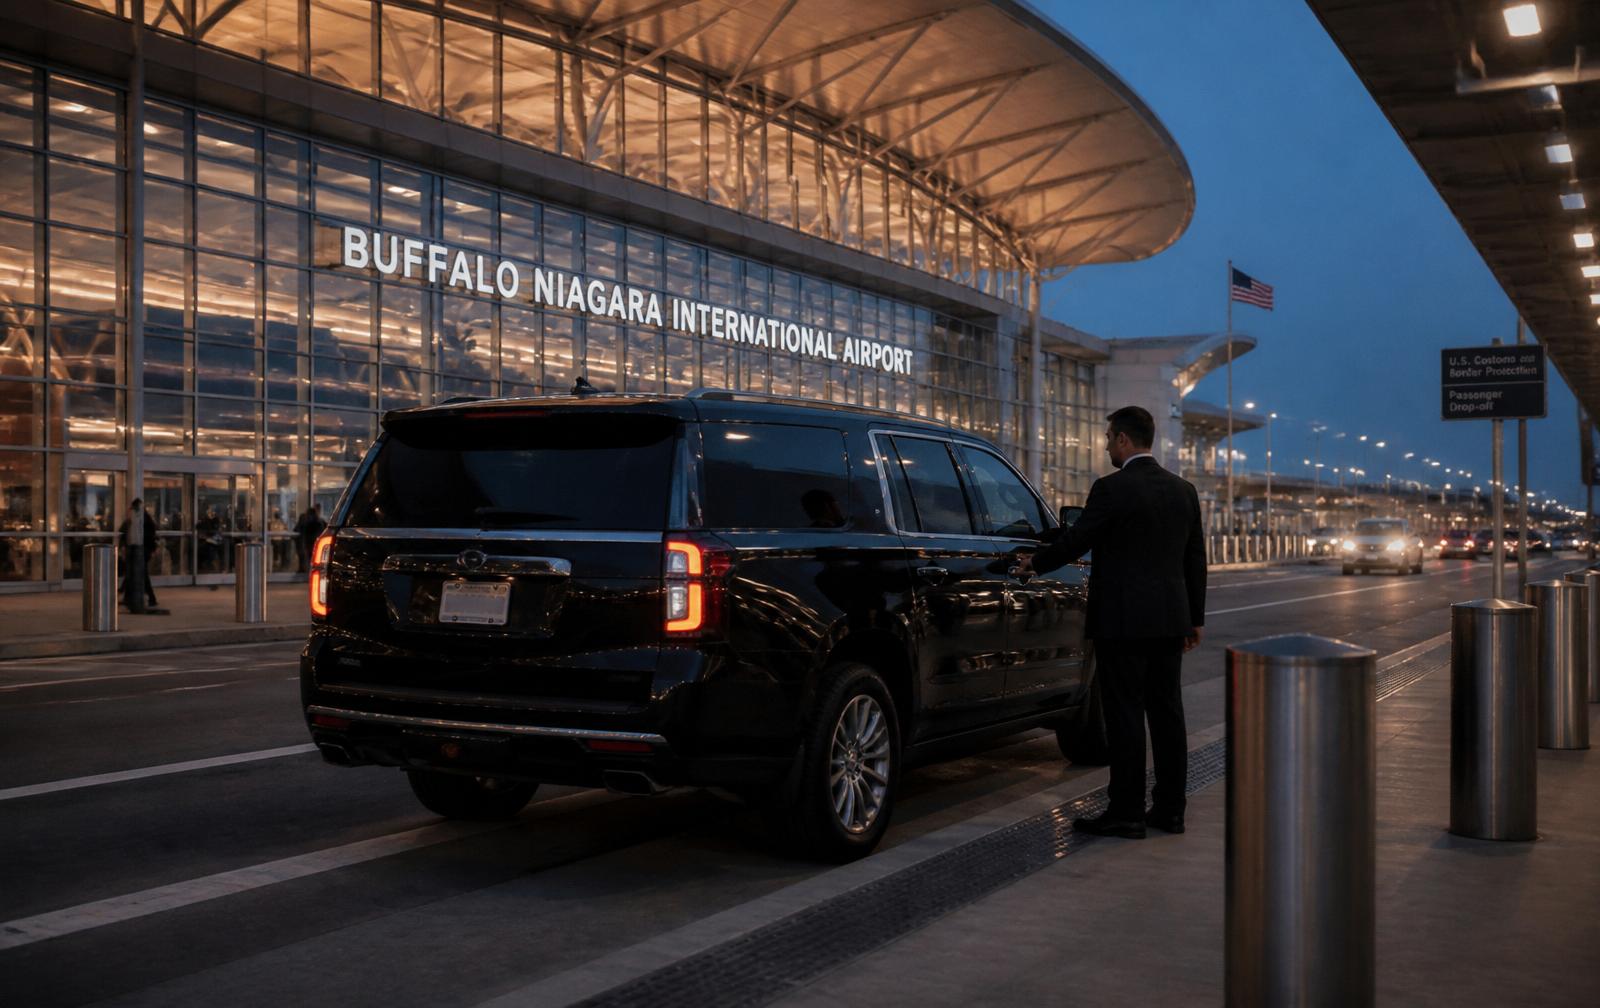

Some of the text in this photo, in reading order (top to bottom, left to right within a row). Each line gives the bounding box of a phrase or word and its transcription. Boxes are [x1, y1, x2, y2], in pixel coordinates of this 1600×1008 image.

[344, 226, 913, 376] BUFFALO NIAGARA INTERNATIONAL AIRPORT
[1449, 356, 1471, 367] U.S.
[1449, 390, 1503, 401] Passenger
[1449, 401, 1495, 413] Drop-off
